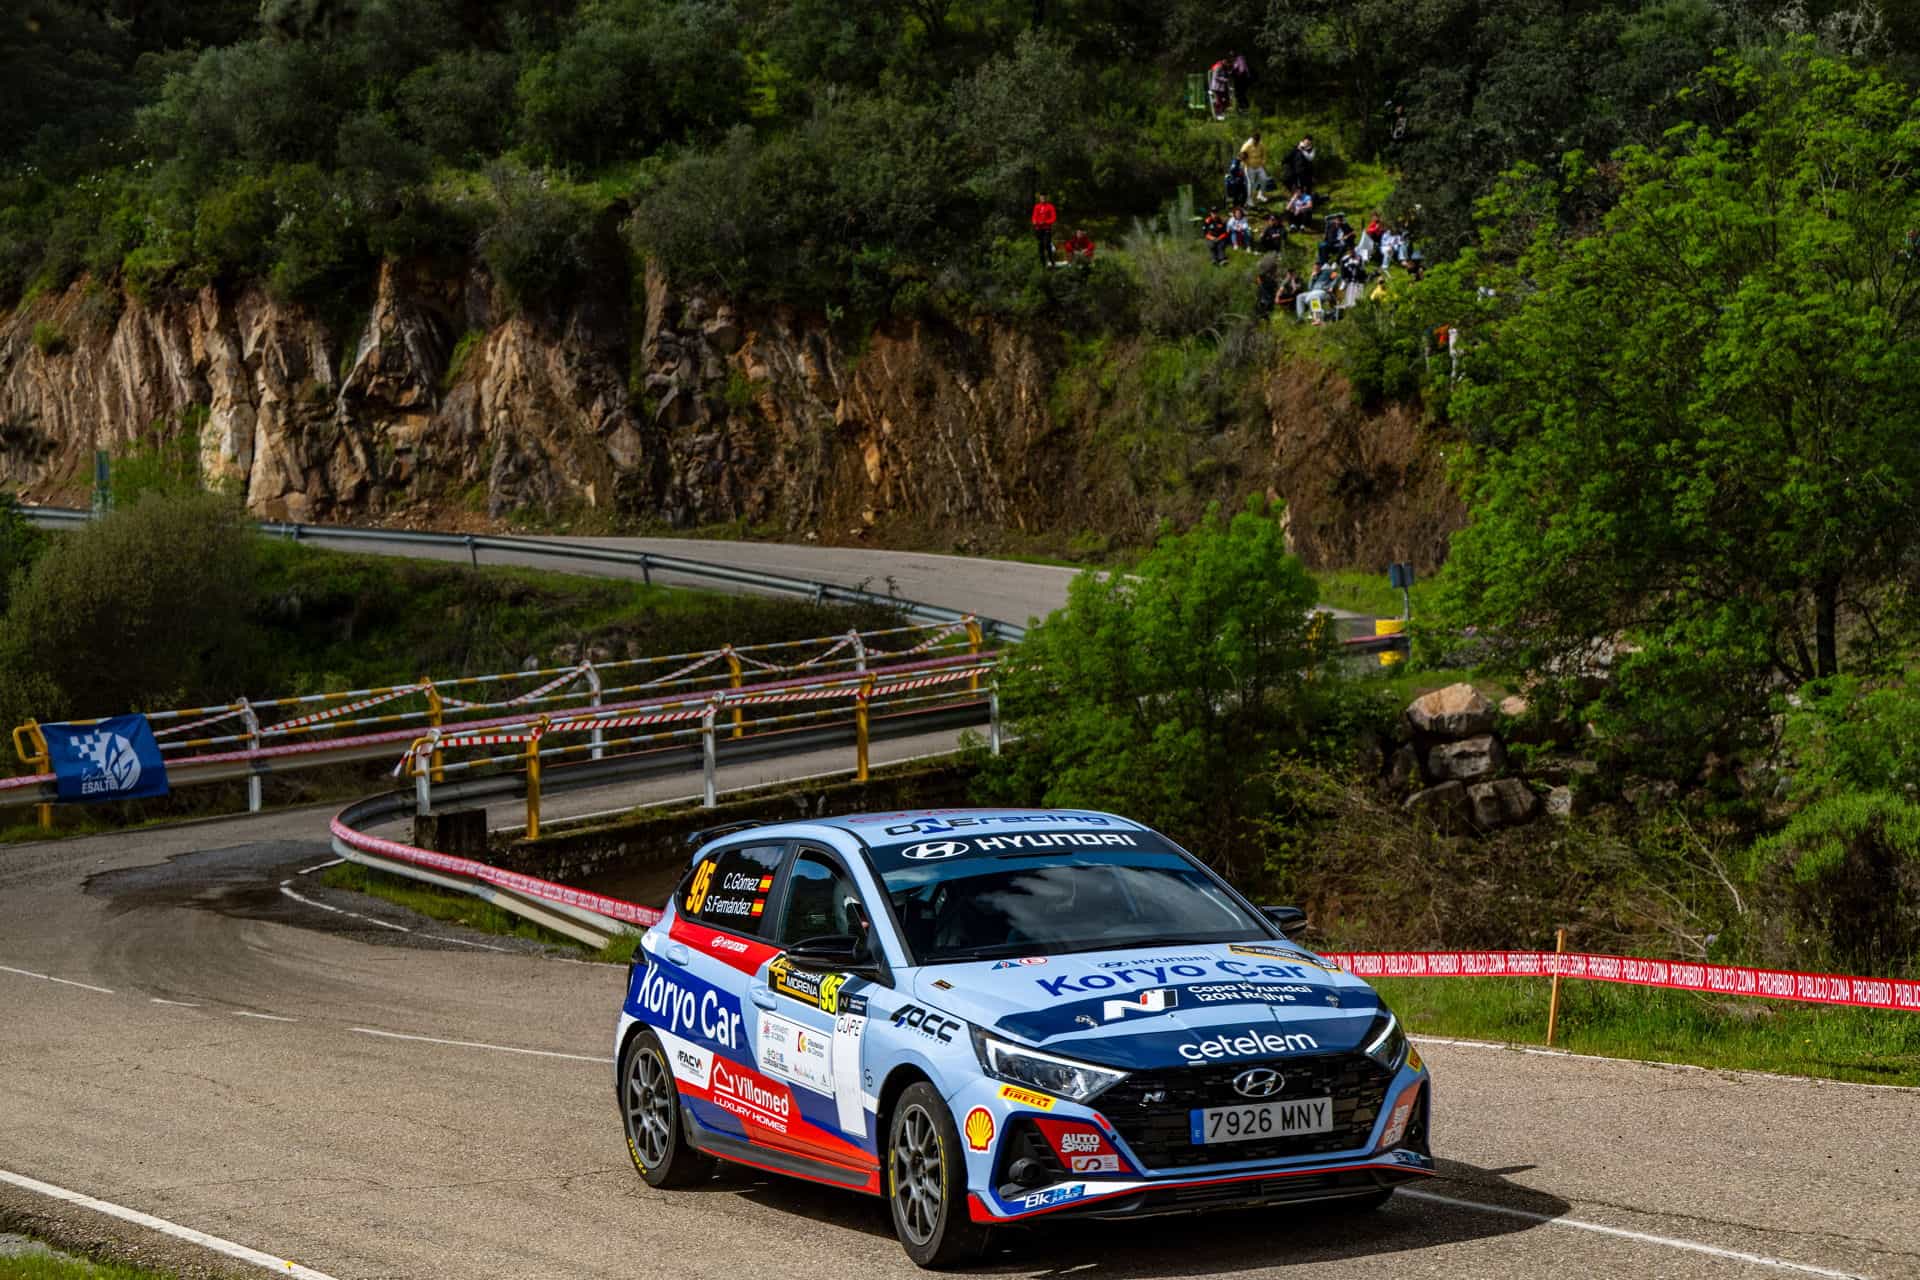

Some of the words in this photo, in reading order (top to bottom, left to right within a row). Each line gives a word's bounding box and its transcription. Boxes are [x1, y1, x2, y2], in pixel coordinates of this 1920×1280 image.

[975, 834, 1137, 850] HYUNDAI
[686, 860, 717, 914] 95
[1131, 956, 1212, 966] HYUNDAI
[787, 976, 818, 997] MORENA
[821, 975, 844, 1013] 95
[1035, 964, 1206, 997] Koryo
[1215, 960, 1307, 979] Car
[1187, 984, 1238, 994] Copa
[1237, 982, 1313, 993] Hyundai
[1353, 955, 1382, 973] PROHIBIDO
[1385, 955, 1409, 973] PUBLICO
[1410, 955, 1426, 973] ZONA
[1428, 955, 1459, 973] PROHIBIDO
[1461, 955, 1487, 973] PUBLICO
[1488, 955, 1505, 972] ZONA
[1507, 955, 1539, 973] PROHIBIDO
[1570, 955, 1586, 974] ZONA
[1589, 956, 1620, 977] PROHIBIDO
[1622, 959, 1649, 981] PUBLICO
[1651, 962, 1668, 983] ZONA
[1671, 964, 1704, 987] PROHIBIDO
[1707, 967, 1736, 990] PUBLICO
[1737, 970, 1755, 992] ZONA
[1758, 972, 1795, 996] PROHIBIDO
[1798, 975, 1828, 999] PUBLICO
[1830, 978, 1849, 1001] ZONA
[1852, 980, 1892, 1005] PROHIBIDO
[637, 960, 696, 1032] Koryo
[701, 990, 741, 1049] Car
[1240, 991, 1297, 1003] Rallye
[1179, 1030, 1318, 1061] cetelem
[735, 1074, 789, 1116] Villamed
[1003, 1087, 1051, 1108] PIRELLI
[713, 1095, 751, 1117] LUXURY
[752, 1112, 788, 1134] HOMES
[1210, 1109, 1272, 1138] 7926
[1281, 1103, 1326, 1131] MNY
[1061, 1144, 1100, 1153] SPORT
[1062, 1134, 1100, 1145] AUTO
